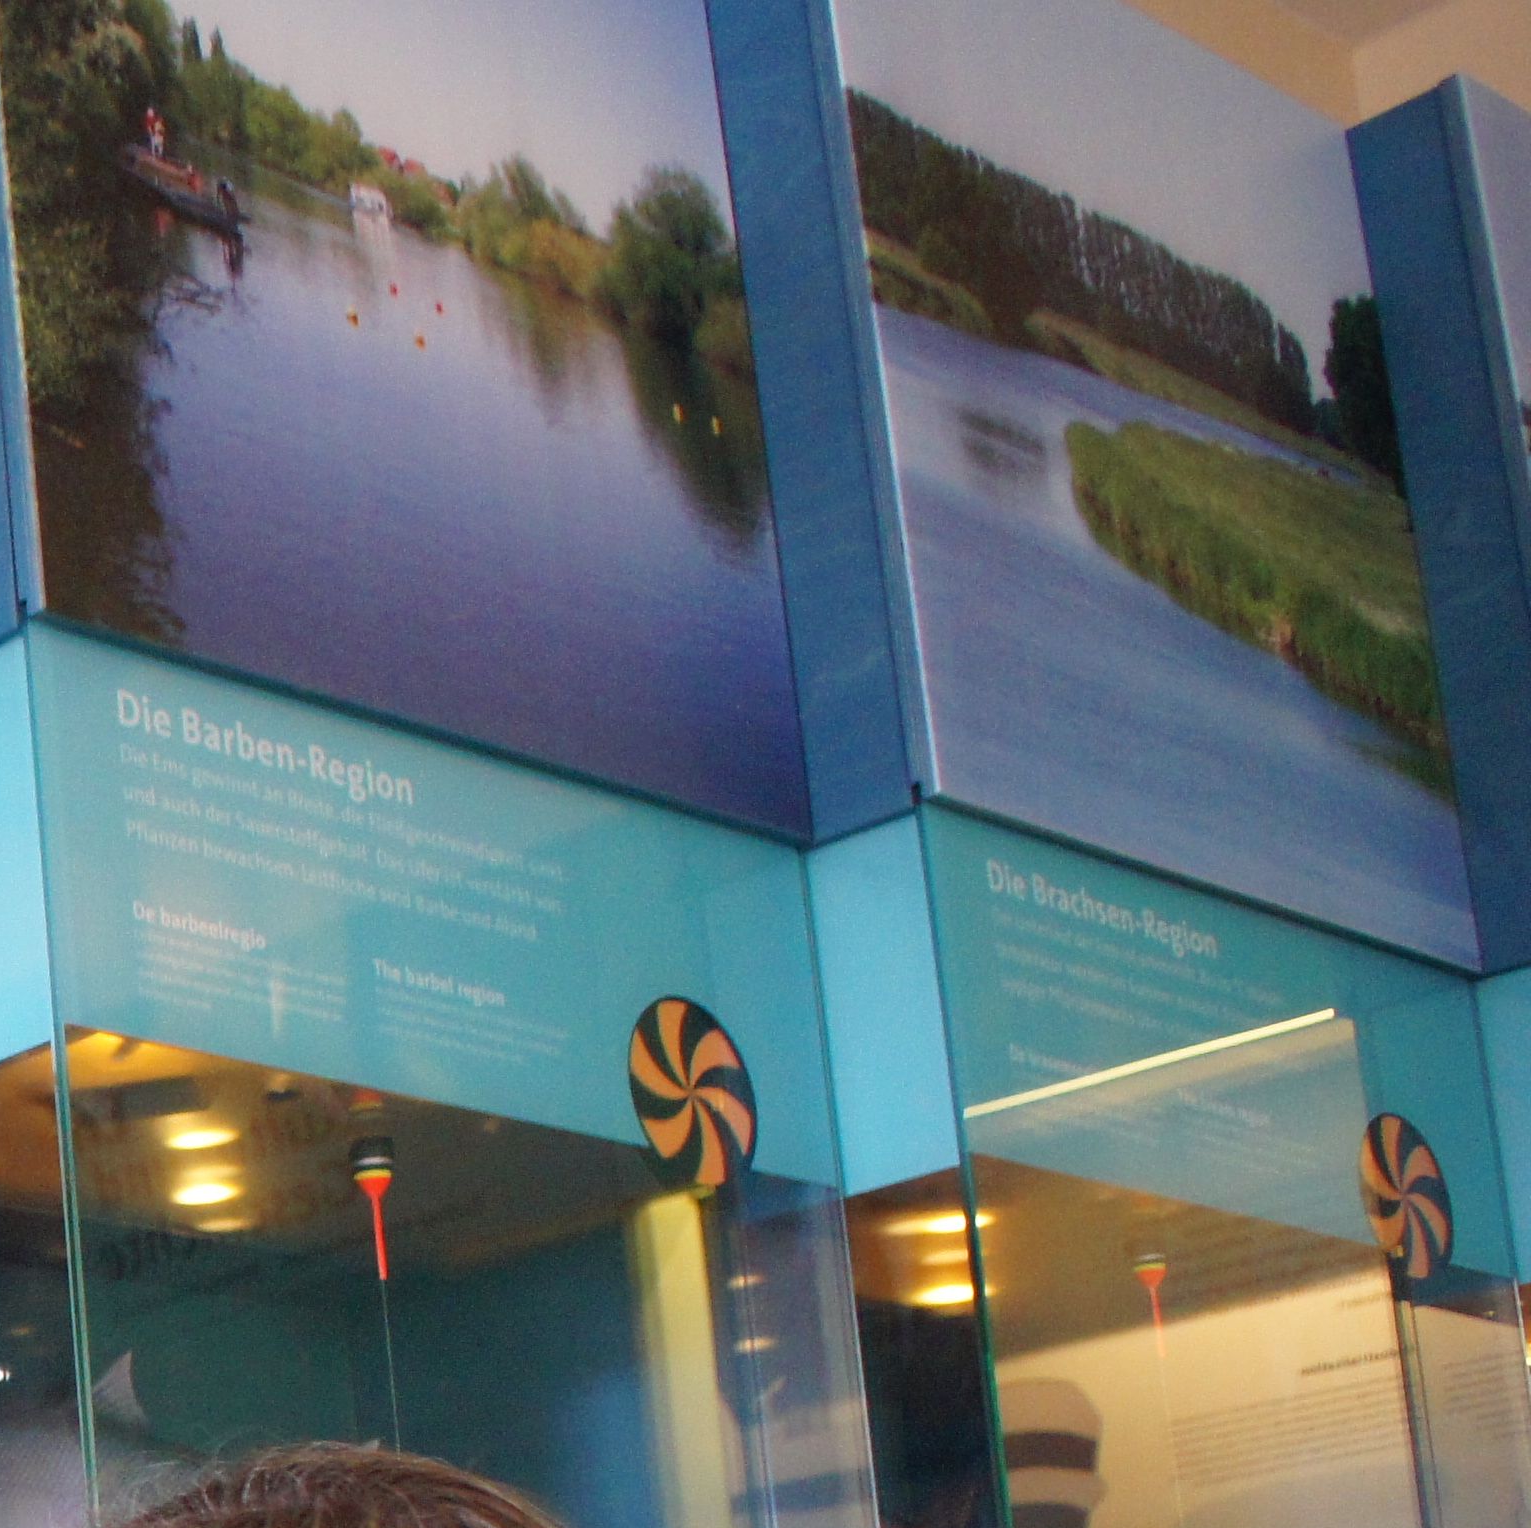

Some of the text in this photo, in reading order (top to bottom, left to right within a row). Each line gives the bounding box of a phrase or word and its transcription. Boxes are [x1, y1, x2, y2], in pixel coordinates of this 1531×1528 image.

[118, 689, 414, 804] Die Barben-Region
[988, 859, 1026, 899] Die
[1033, 874, 1217, 957] Brachsen-Region
